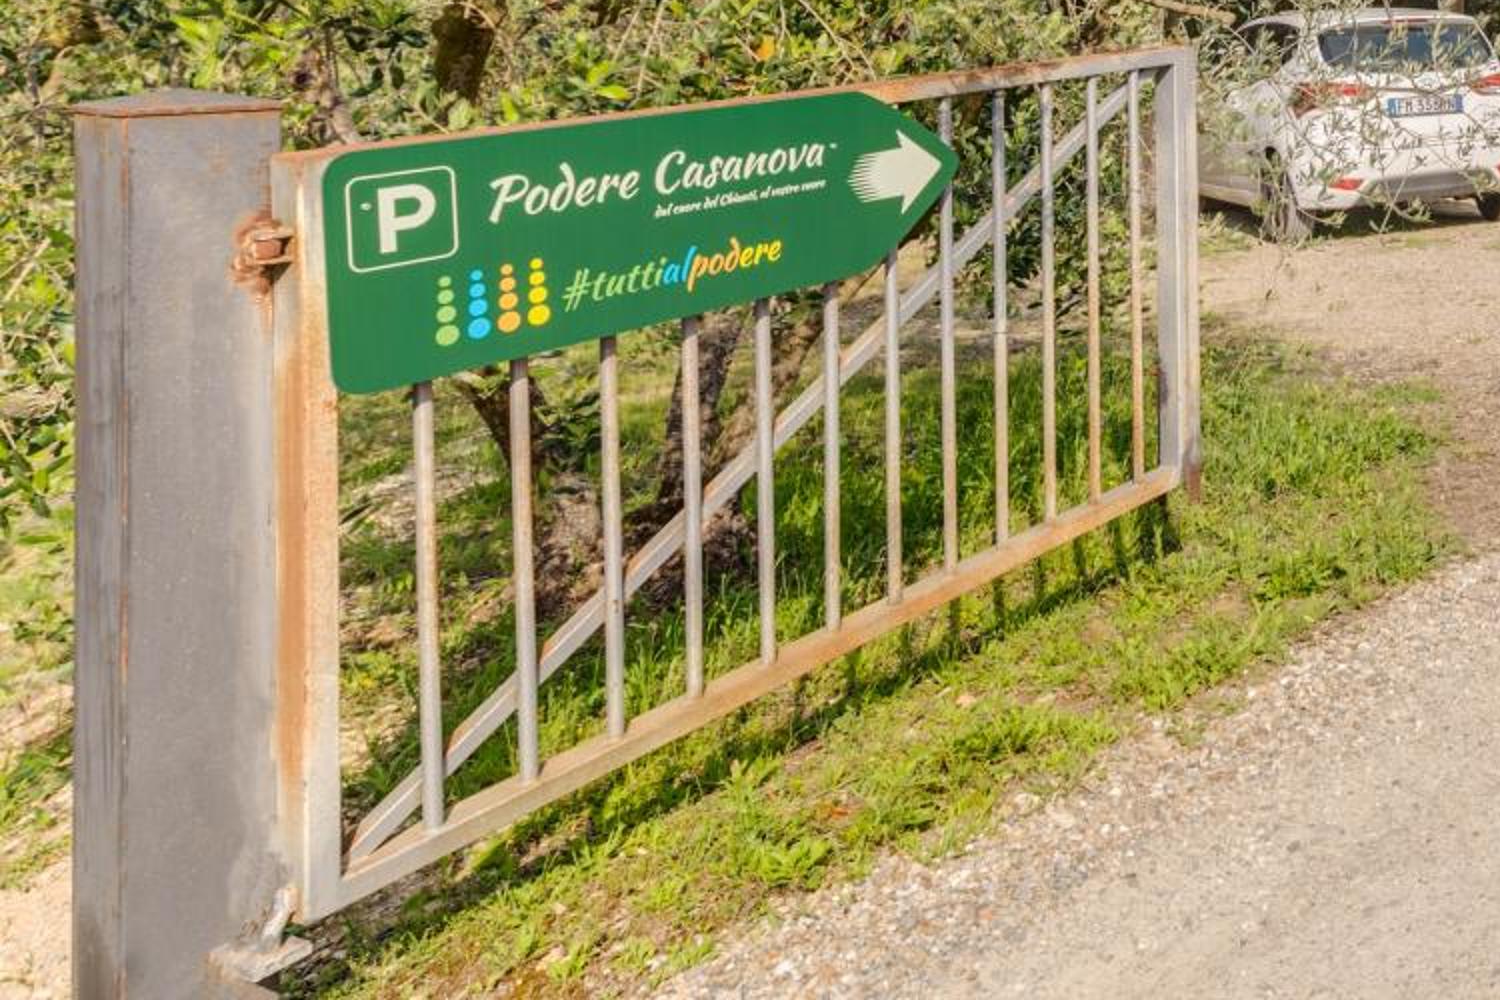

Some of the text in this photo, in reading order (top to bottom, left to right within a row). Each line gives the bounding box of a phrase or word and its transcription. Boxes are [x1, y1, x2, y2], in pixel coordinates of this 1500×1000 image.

[377, 183, 437, 254] P
[489, 143, 826, 224] Podere Casanova
[562, 237, 782, 312] #tuttialpodere
